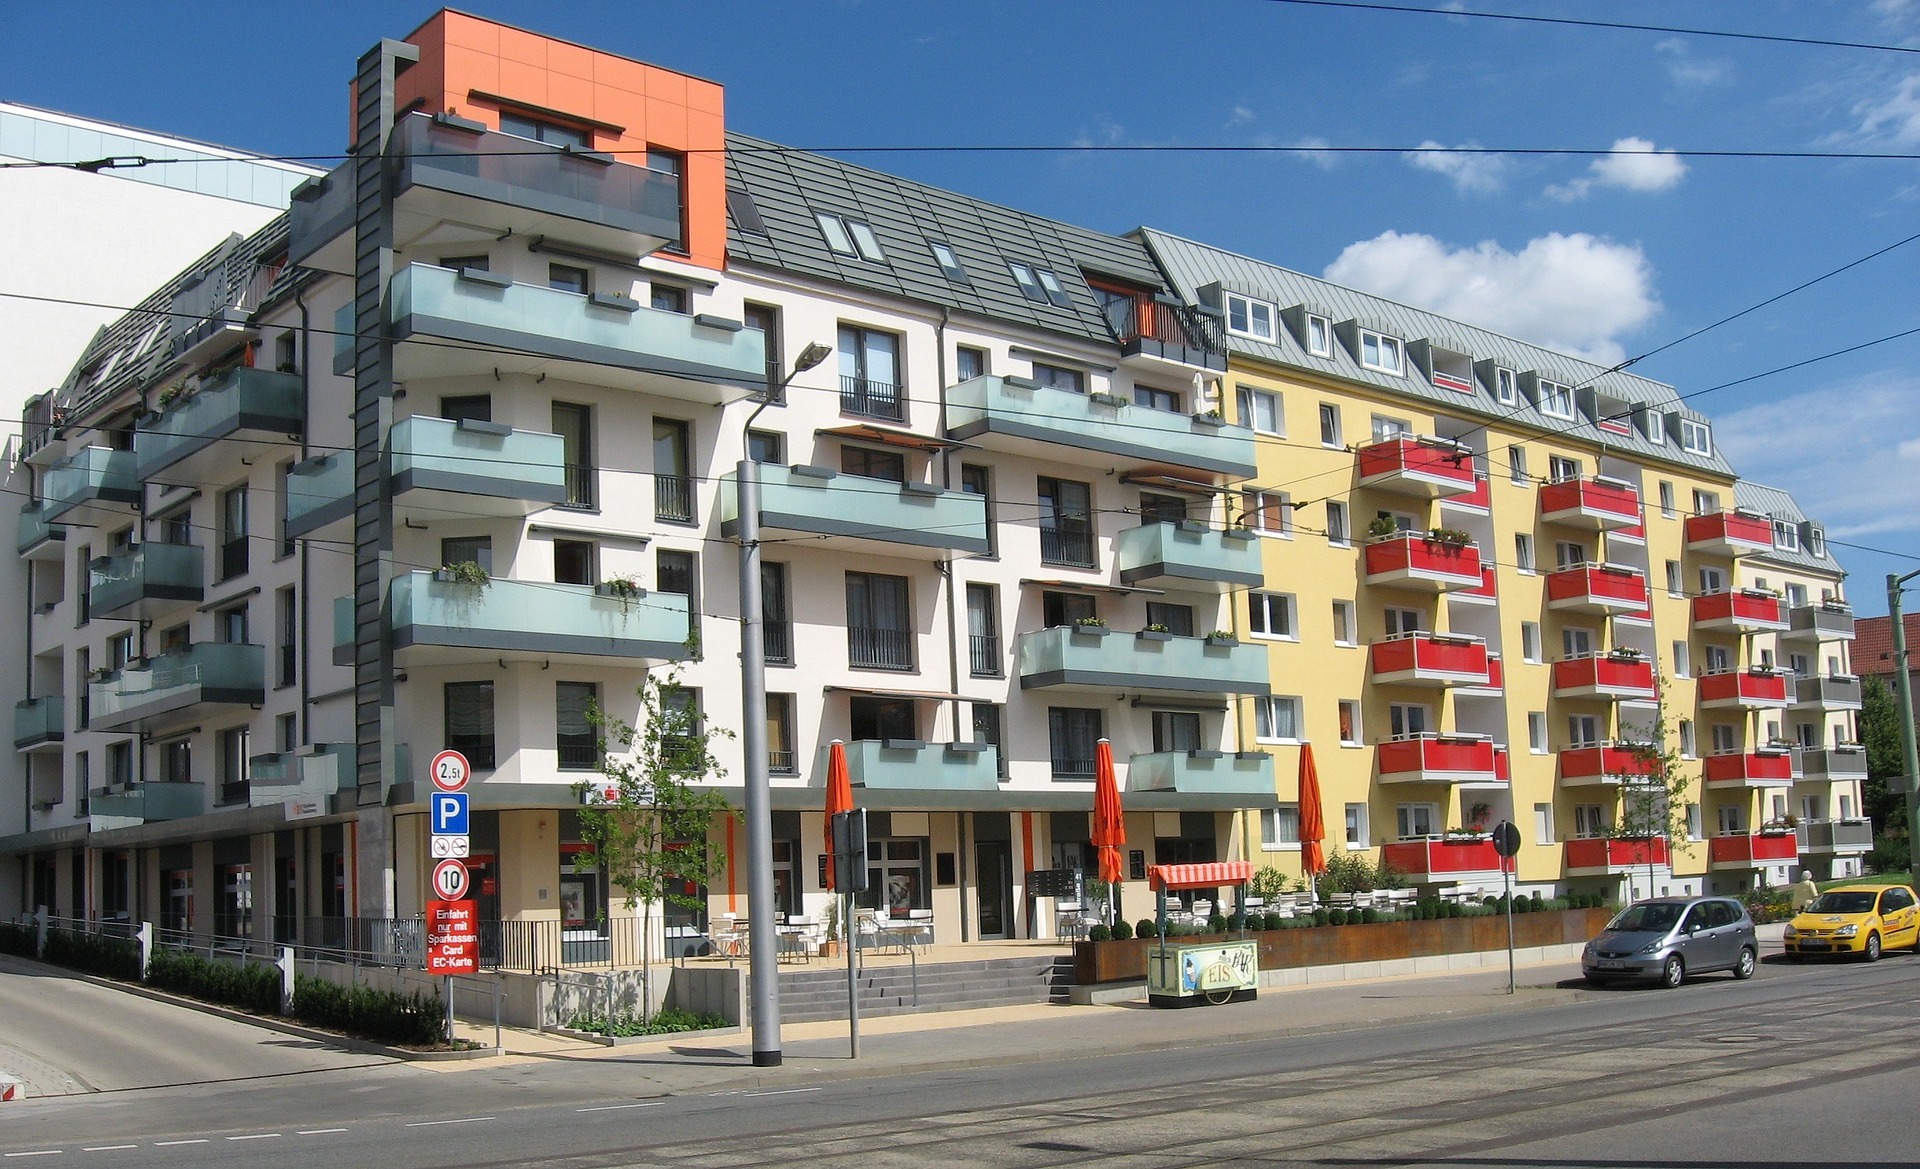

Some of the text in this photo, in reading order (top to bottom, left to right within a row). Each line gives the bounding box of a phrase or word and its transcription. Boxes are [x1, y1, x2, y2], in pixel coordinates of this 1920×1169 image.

[440, 797, 461, 829] P
[442, 869, 461, 890] 10
[1074, 872, 1082, 880] 41
[436, 909, 469, 920] Einfahrt
[437, 921, 468, 931] nur mit
[428, 933, 477, 946] Sparkassen
[442, 945, 464, 955] Card
[432, 957, 473, 968] EC-Karte
[1208, 964, 1231, 983] EIS
